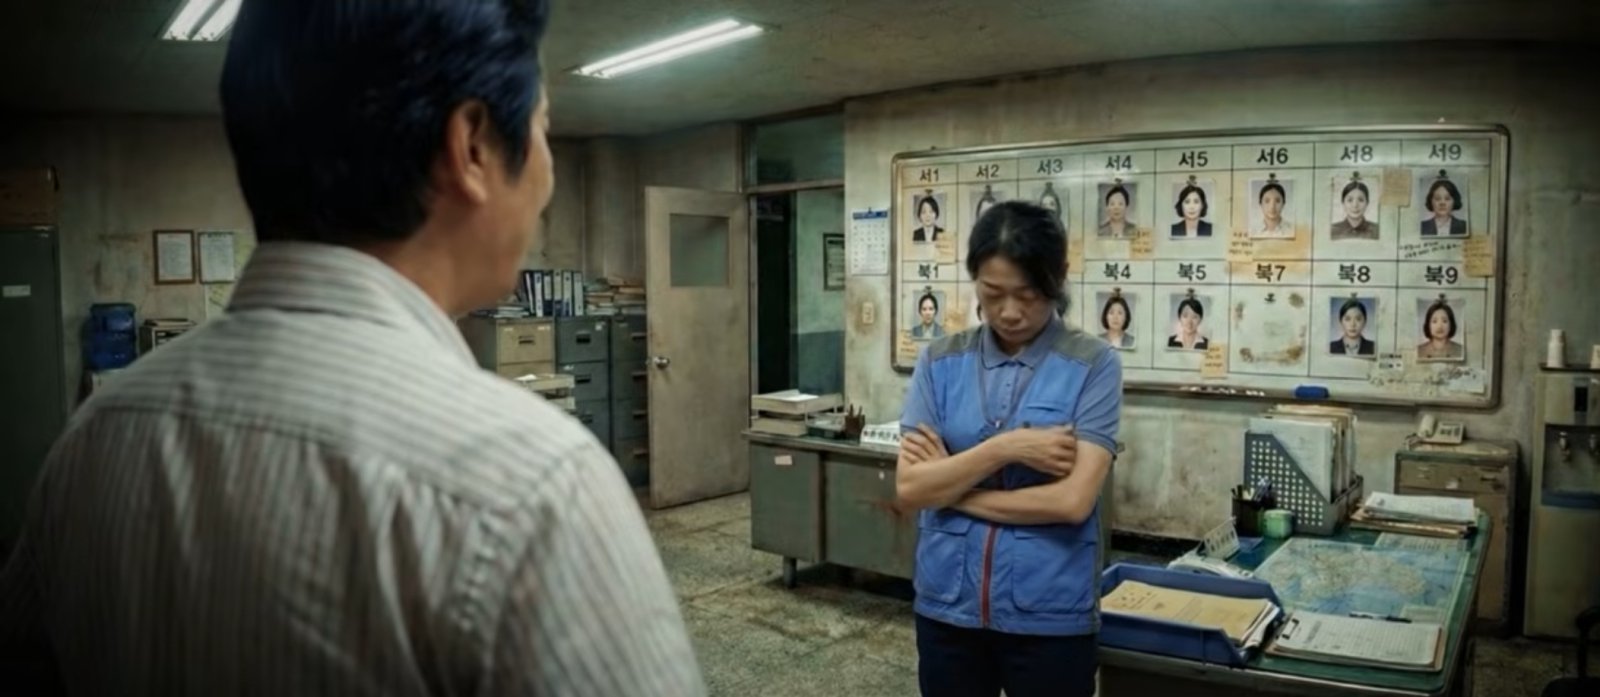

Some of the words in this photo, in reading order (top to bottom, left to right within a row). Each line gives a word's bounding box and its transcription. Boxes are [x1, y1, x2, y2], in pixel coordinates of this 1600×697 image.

[1178, 150, 1208, 168] 서5
[1257, 147, 1289, 165] 서6
[1340, 145, 1374, 163] 서8
[1428, 143, 1462, 162] 서9
[976, 164, 1000, 179] 서2
[1036, 159, 1063, 175] 서3
[1105, 155, 1132, 171] 서4
[919, 168, 939, 183] 서1
[918, 263, 940, 281] 북1
[1103, 262, 1131, 281] 북4
[1177, 262, 1207, 282] 북5
[1254, 263, 1286, 284] 북7
[1337, 264, 1371, 285] 북8
[1424, 265, 1459, 286] 북9
